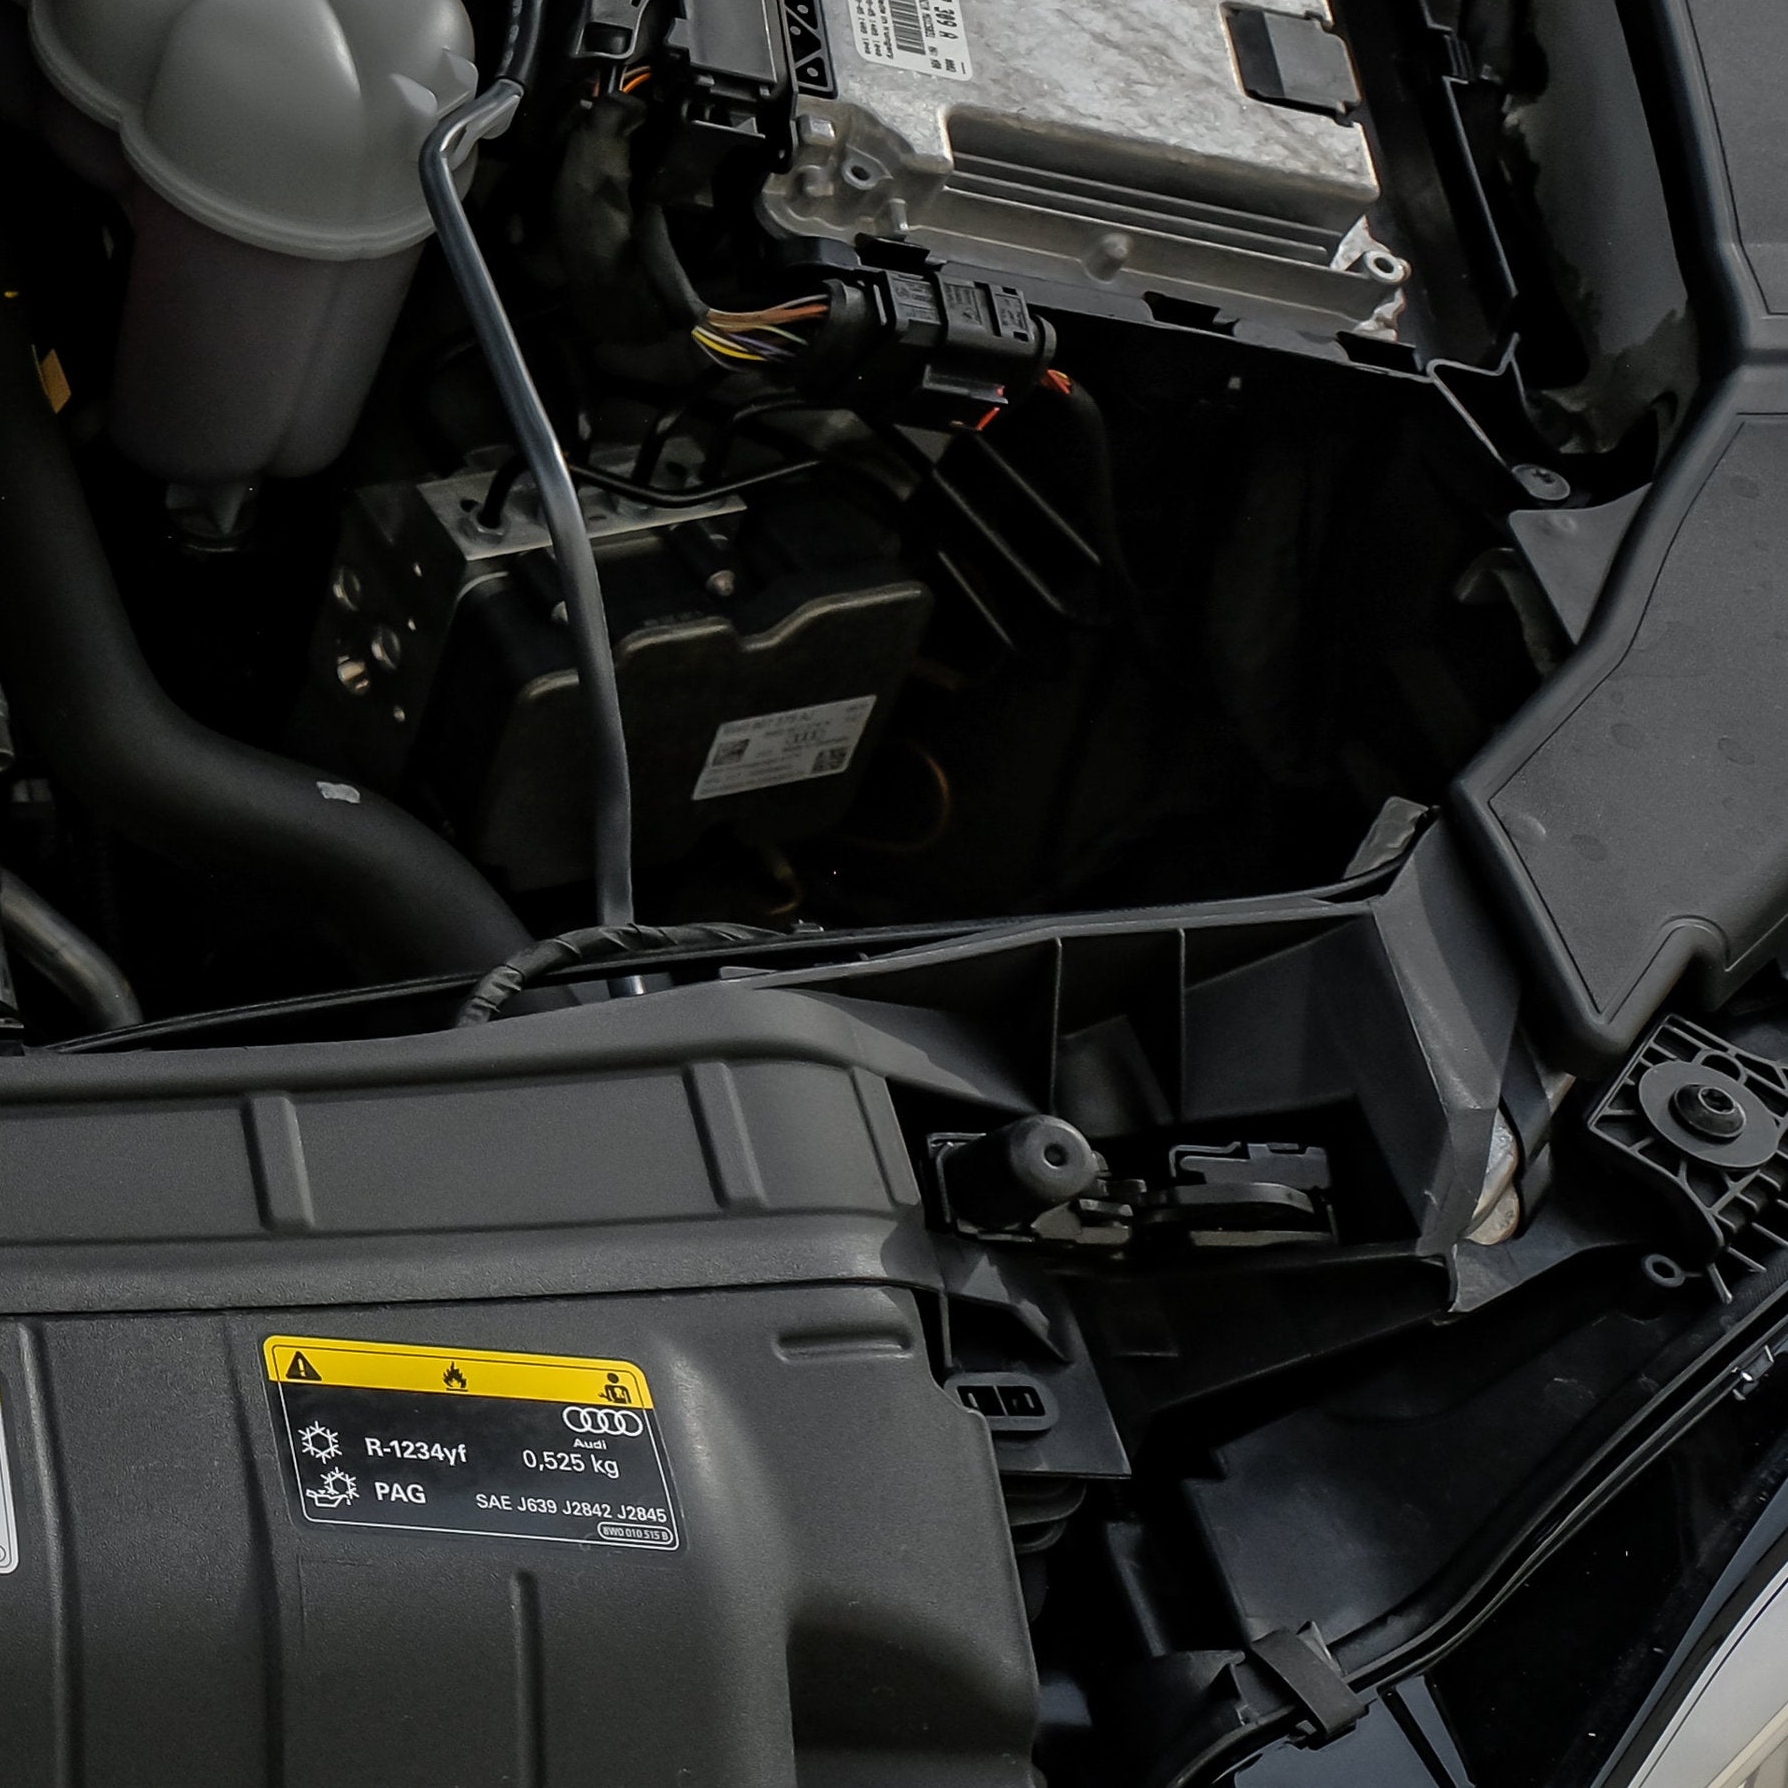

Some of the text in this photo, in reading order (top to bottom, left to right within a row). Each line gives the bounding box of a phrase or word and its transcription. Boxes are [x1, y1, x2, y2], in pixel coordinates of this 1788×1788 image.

[365, 1437, 467, 1466] R-1234yf
[573, 1438, 607, 1450] Audi
[523, 1449, 619, 1479] 0,525 kg
[374, 1481, 426, 1504] PAG
[475, 1493, 667, 1523] SAE J639 J2842 J2845
